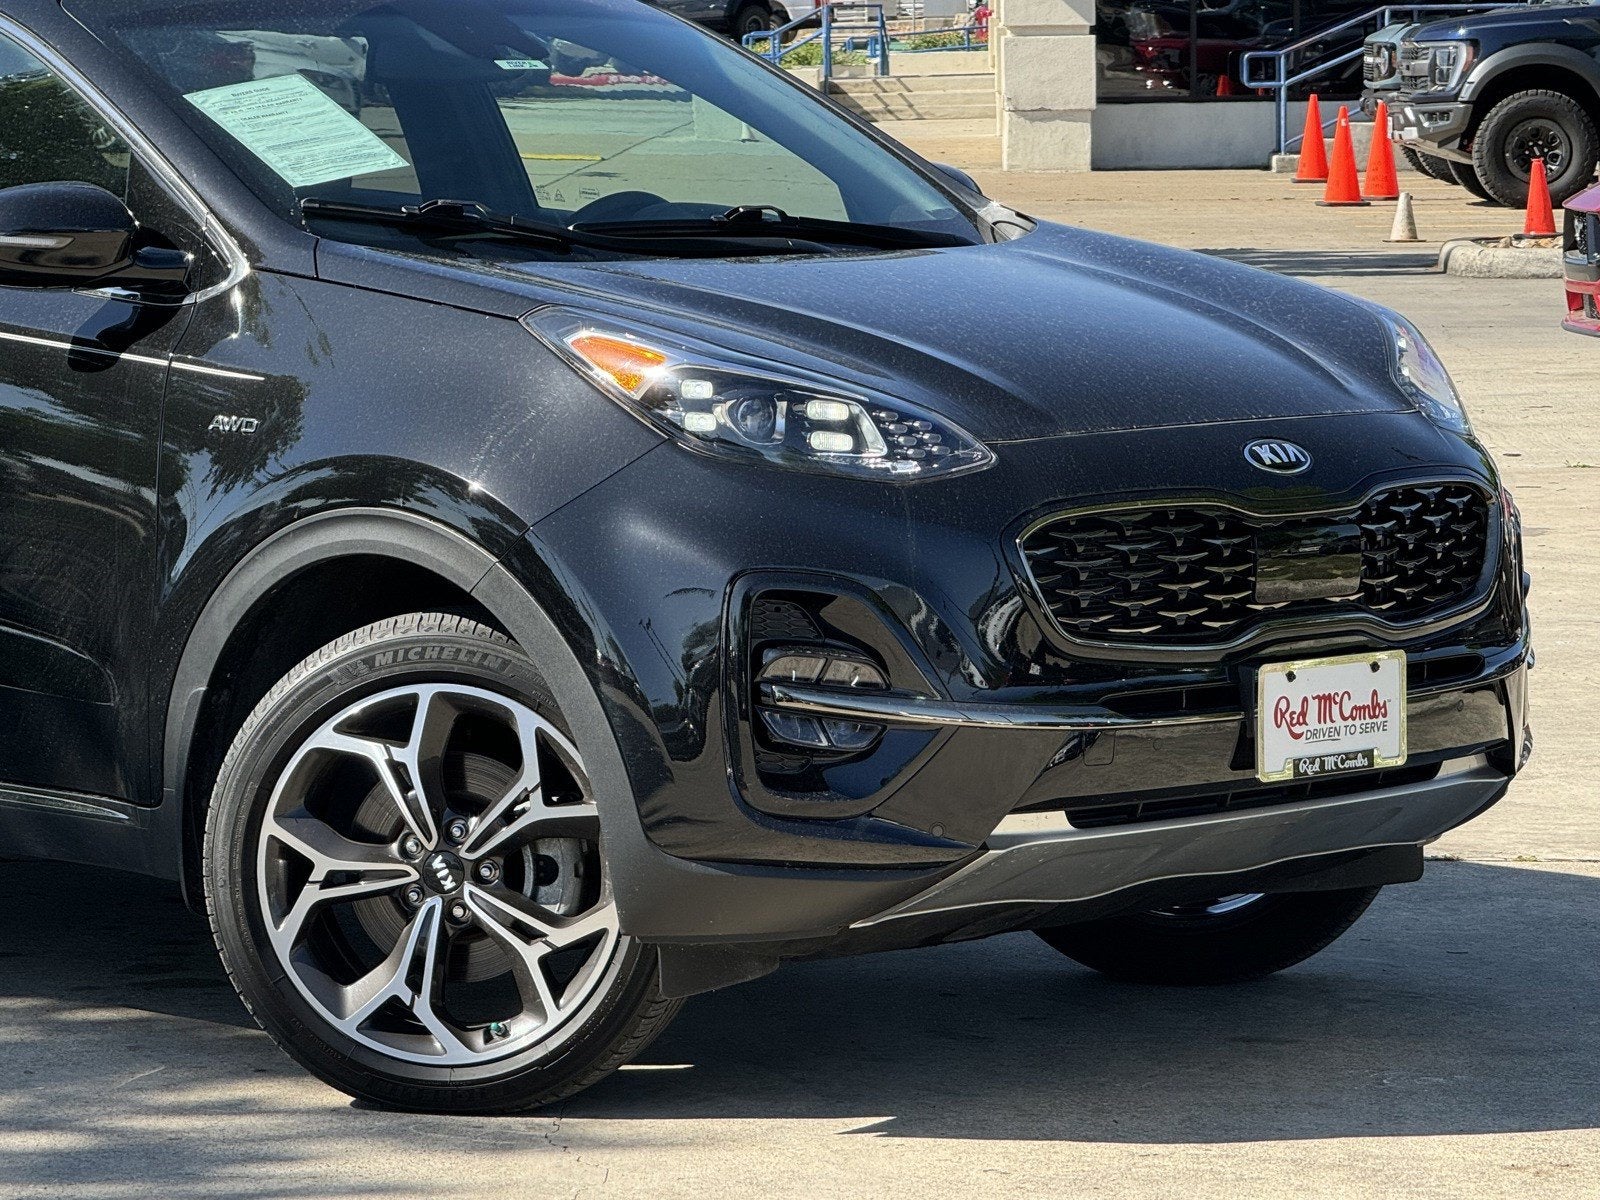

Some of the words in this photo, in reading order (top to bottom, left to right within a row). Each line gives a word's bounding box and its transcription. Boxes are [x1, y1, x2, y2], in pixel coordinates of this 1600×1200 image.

[207, 414, 259, 433] AWD
[1251, 443, 1306, 465] KIA
[373, 645, 503, 671] MICHELIN
[1273, 695, 1309, 740] Red
[1311, 688, 1389, 725] McCombs
[1305, 725, 1341, 741] DRIVEN
[1343, 723, 1357, 736] TO
[1359, 720, 1388, 735] SERVE
[1299, 757, 1321, 776] Red
[1321, 752, 1369, 771] McCombs
[431, 854, 457, 891] KIA
